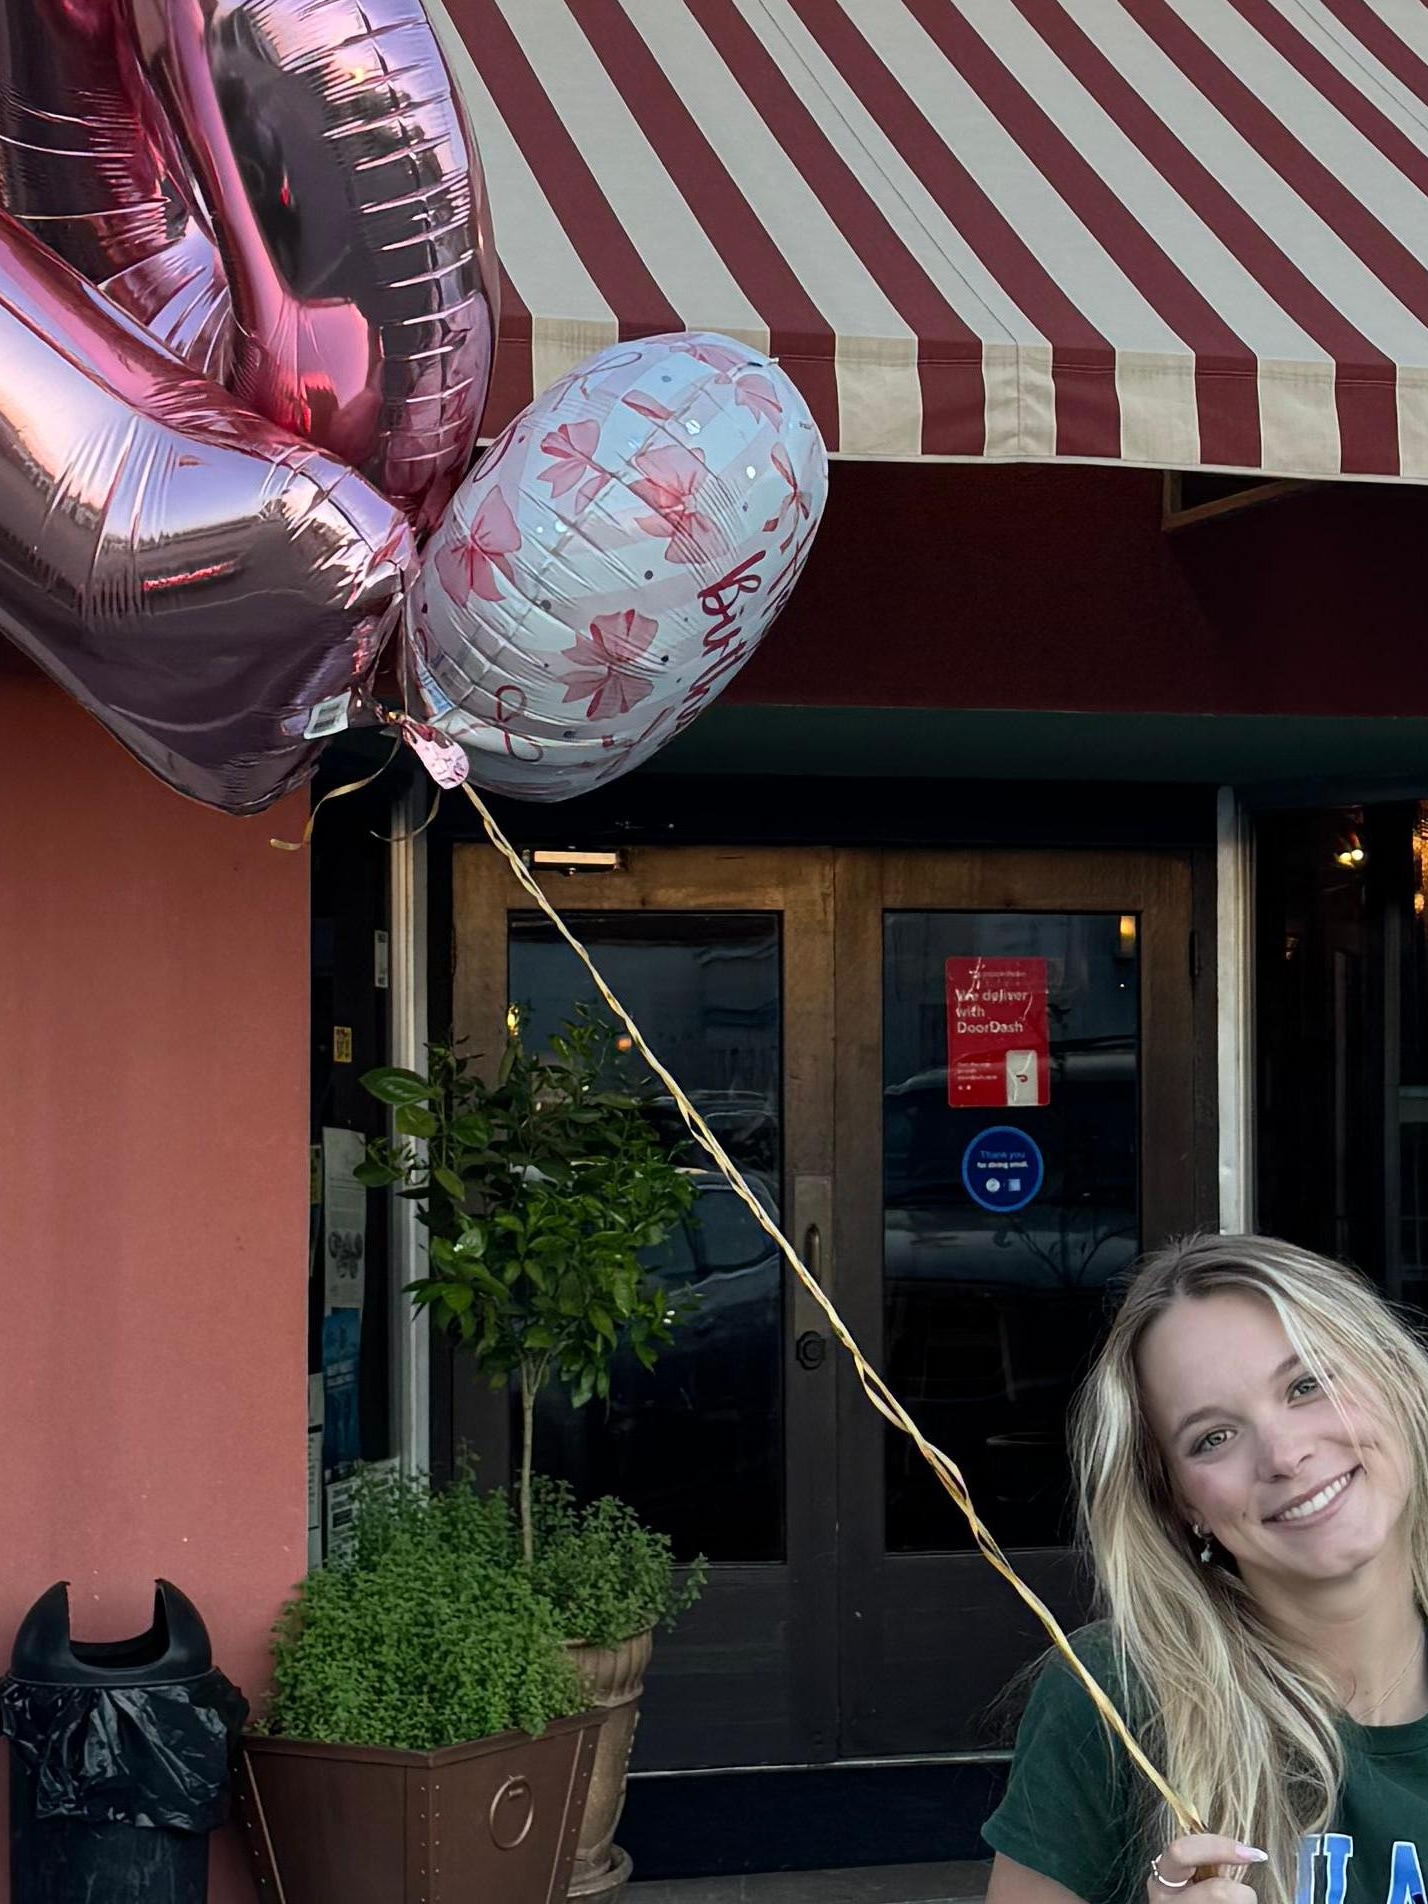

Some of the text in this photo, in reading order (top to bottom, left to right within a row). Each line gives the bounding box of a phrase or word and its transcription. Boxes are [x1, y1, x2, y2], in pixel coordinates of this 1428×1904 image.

[982, 989, 1028, 1002] deliver
[956, 1005, 985, 1018] with
[957, 1020, 1024, 1034] DoorDash
